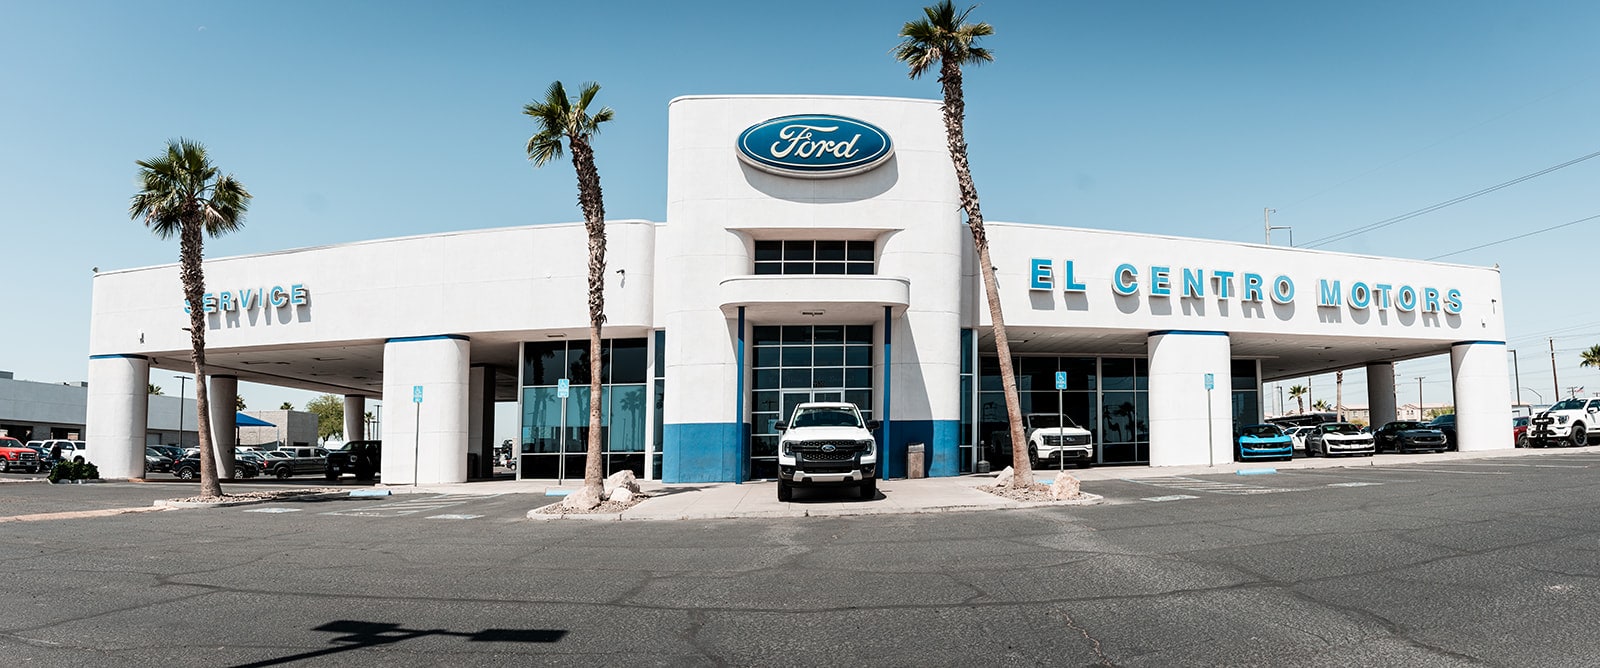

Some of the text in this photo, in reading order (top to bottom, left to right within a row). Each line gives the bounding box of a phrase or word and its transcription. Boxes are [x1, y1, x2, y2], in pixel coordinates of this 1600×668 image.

[771, 125, 860, 158] Ford
[1030, 258, 1463, 315] EL CENTRO MOTORS
